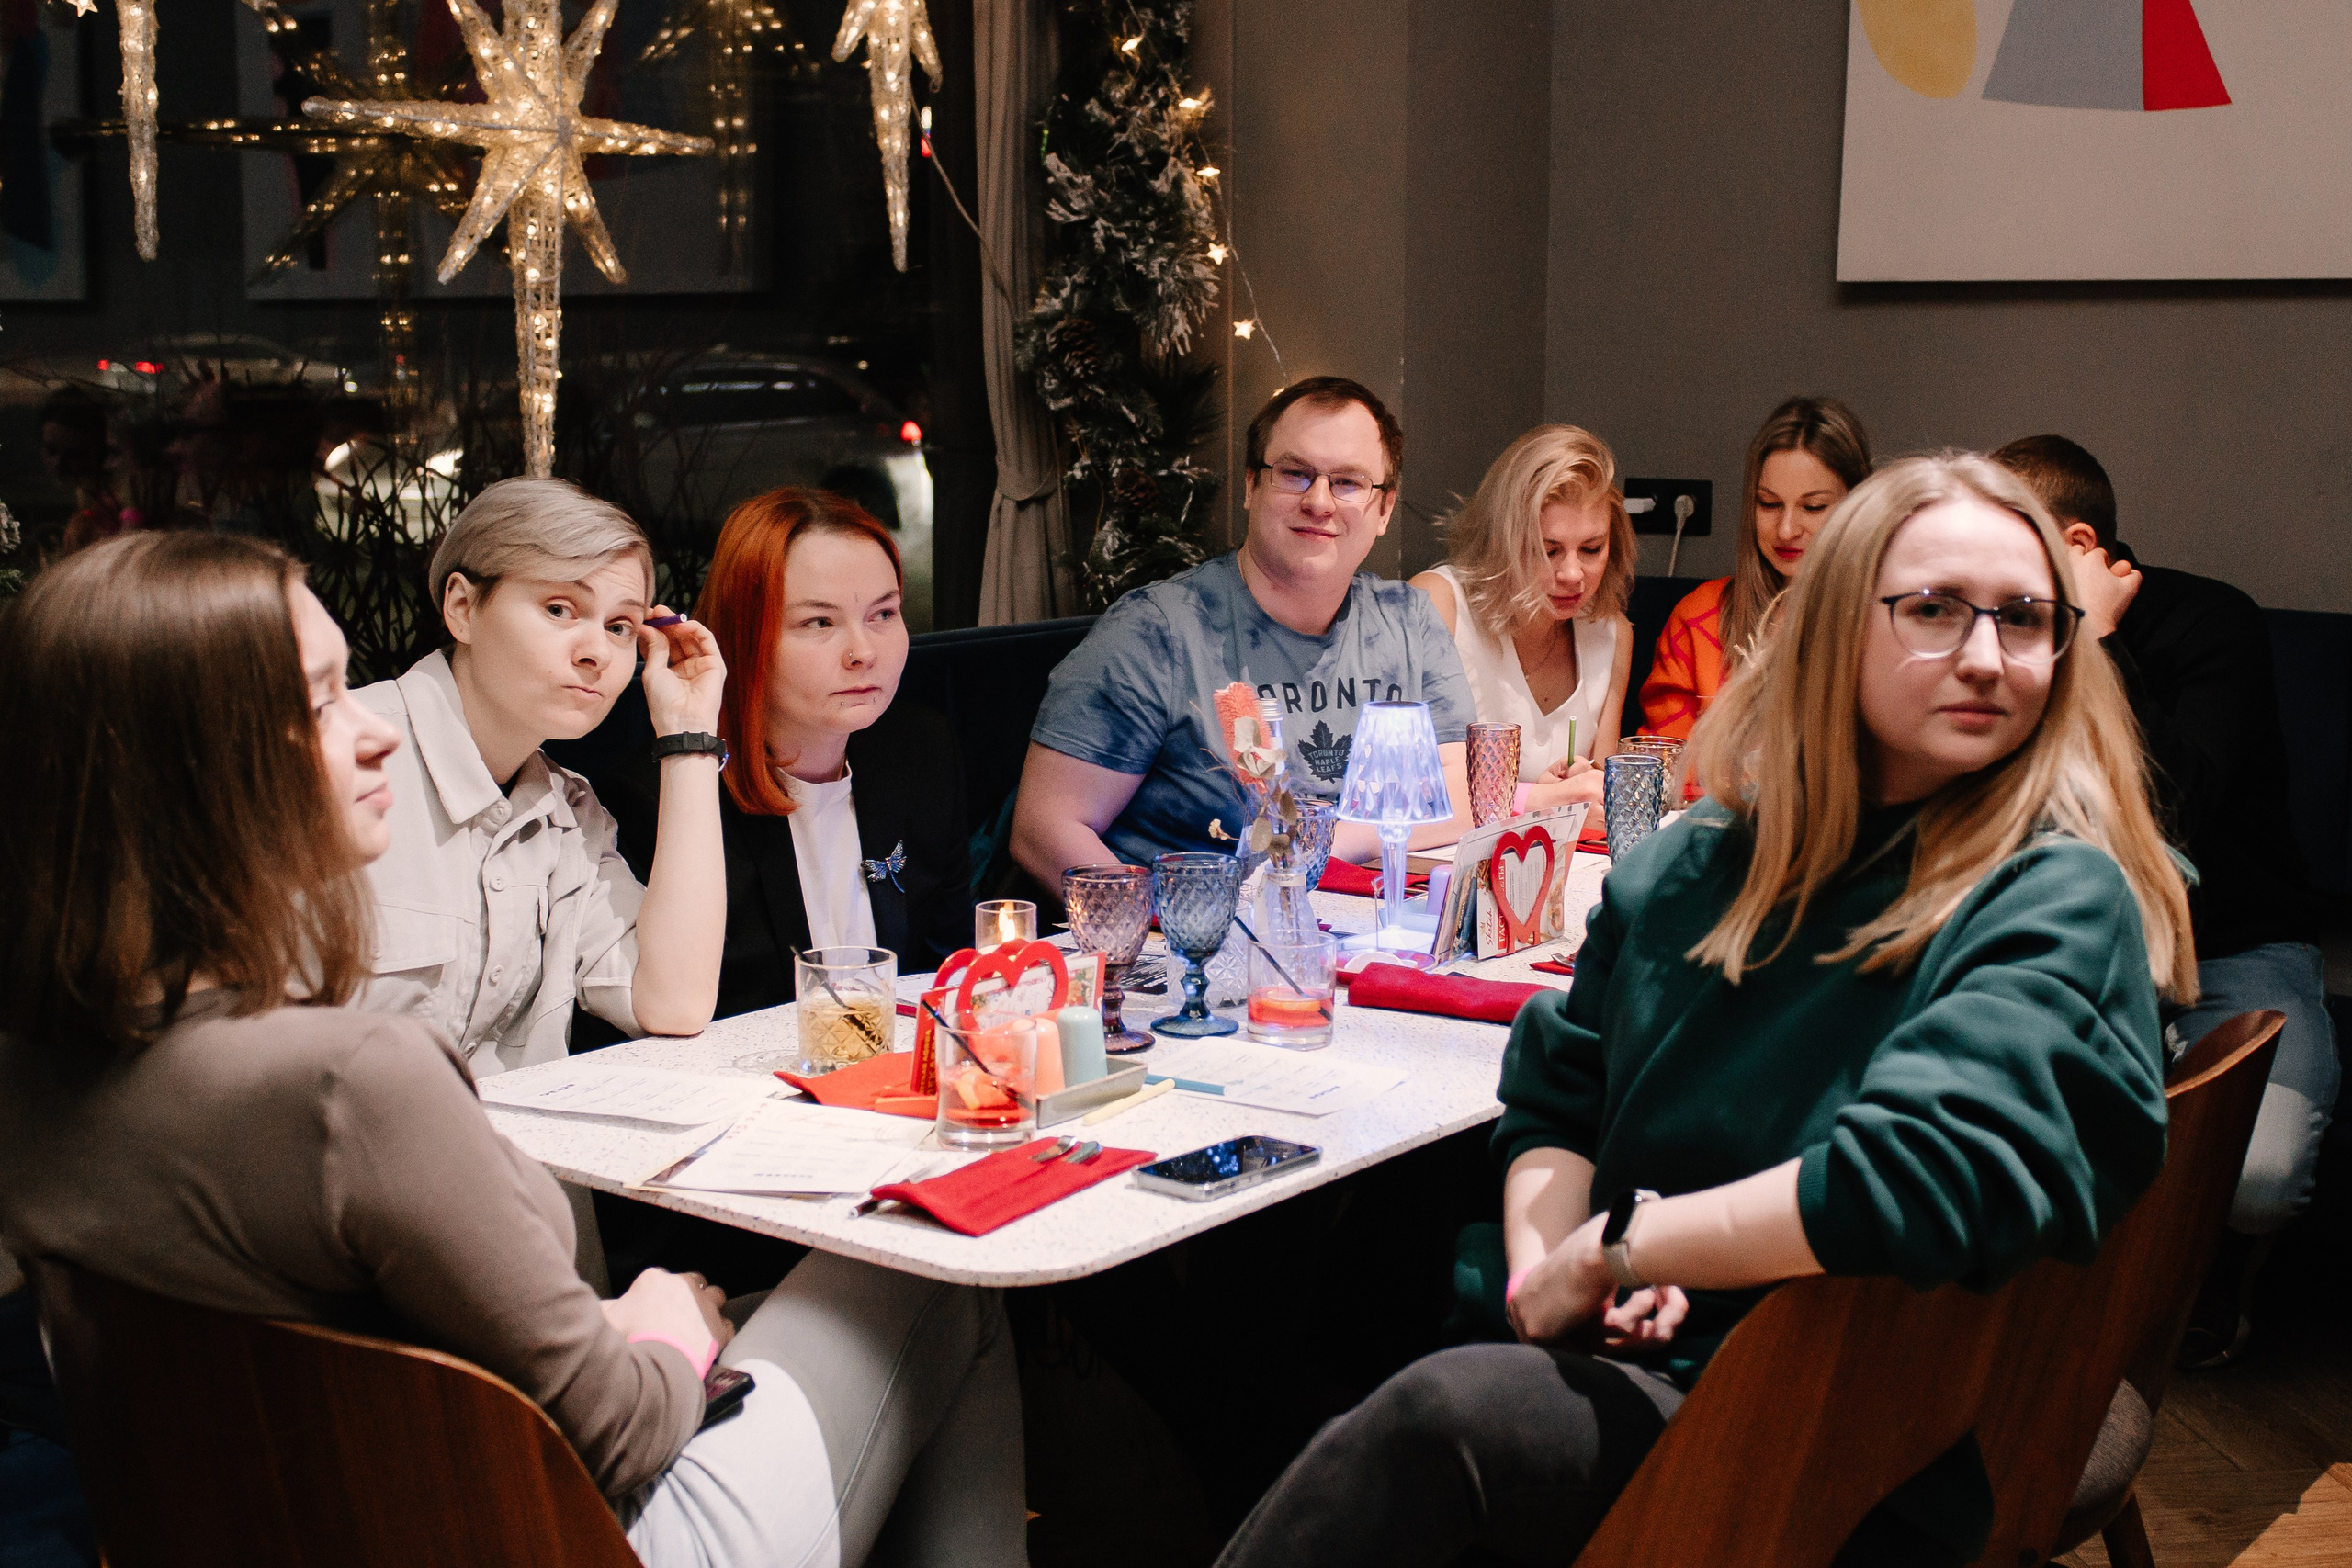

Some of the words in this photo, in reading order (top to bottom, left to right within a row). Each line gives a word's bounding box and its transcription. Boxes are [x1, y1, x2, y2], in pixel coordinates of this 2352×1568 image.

[1256, 677, 1403, 714] ORONTO
[1307, 749, 1345, 761] TORONTO
[1314, 756, 1340, 766] MAPLE
[1316, 762, 1342, 773] LEAFS
